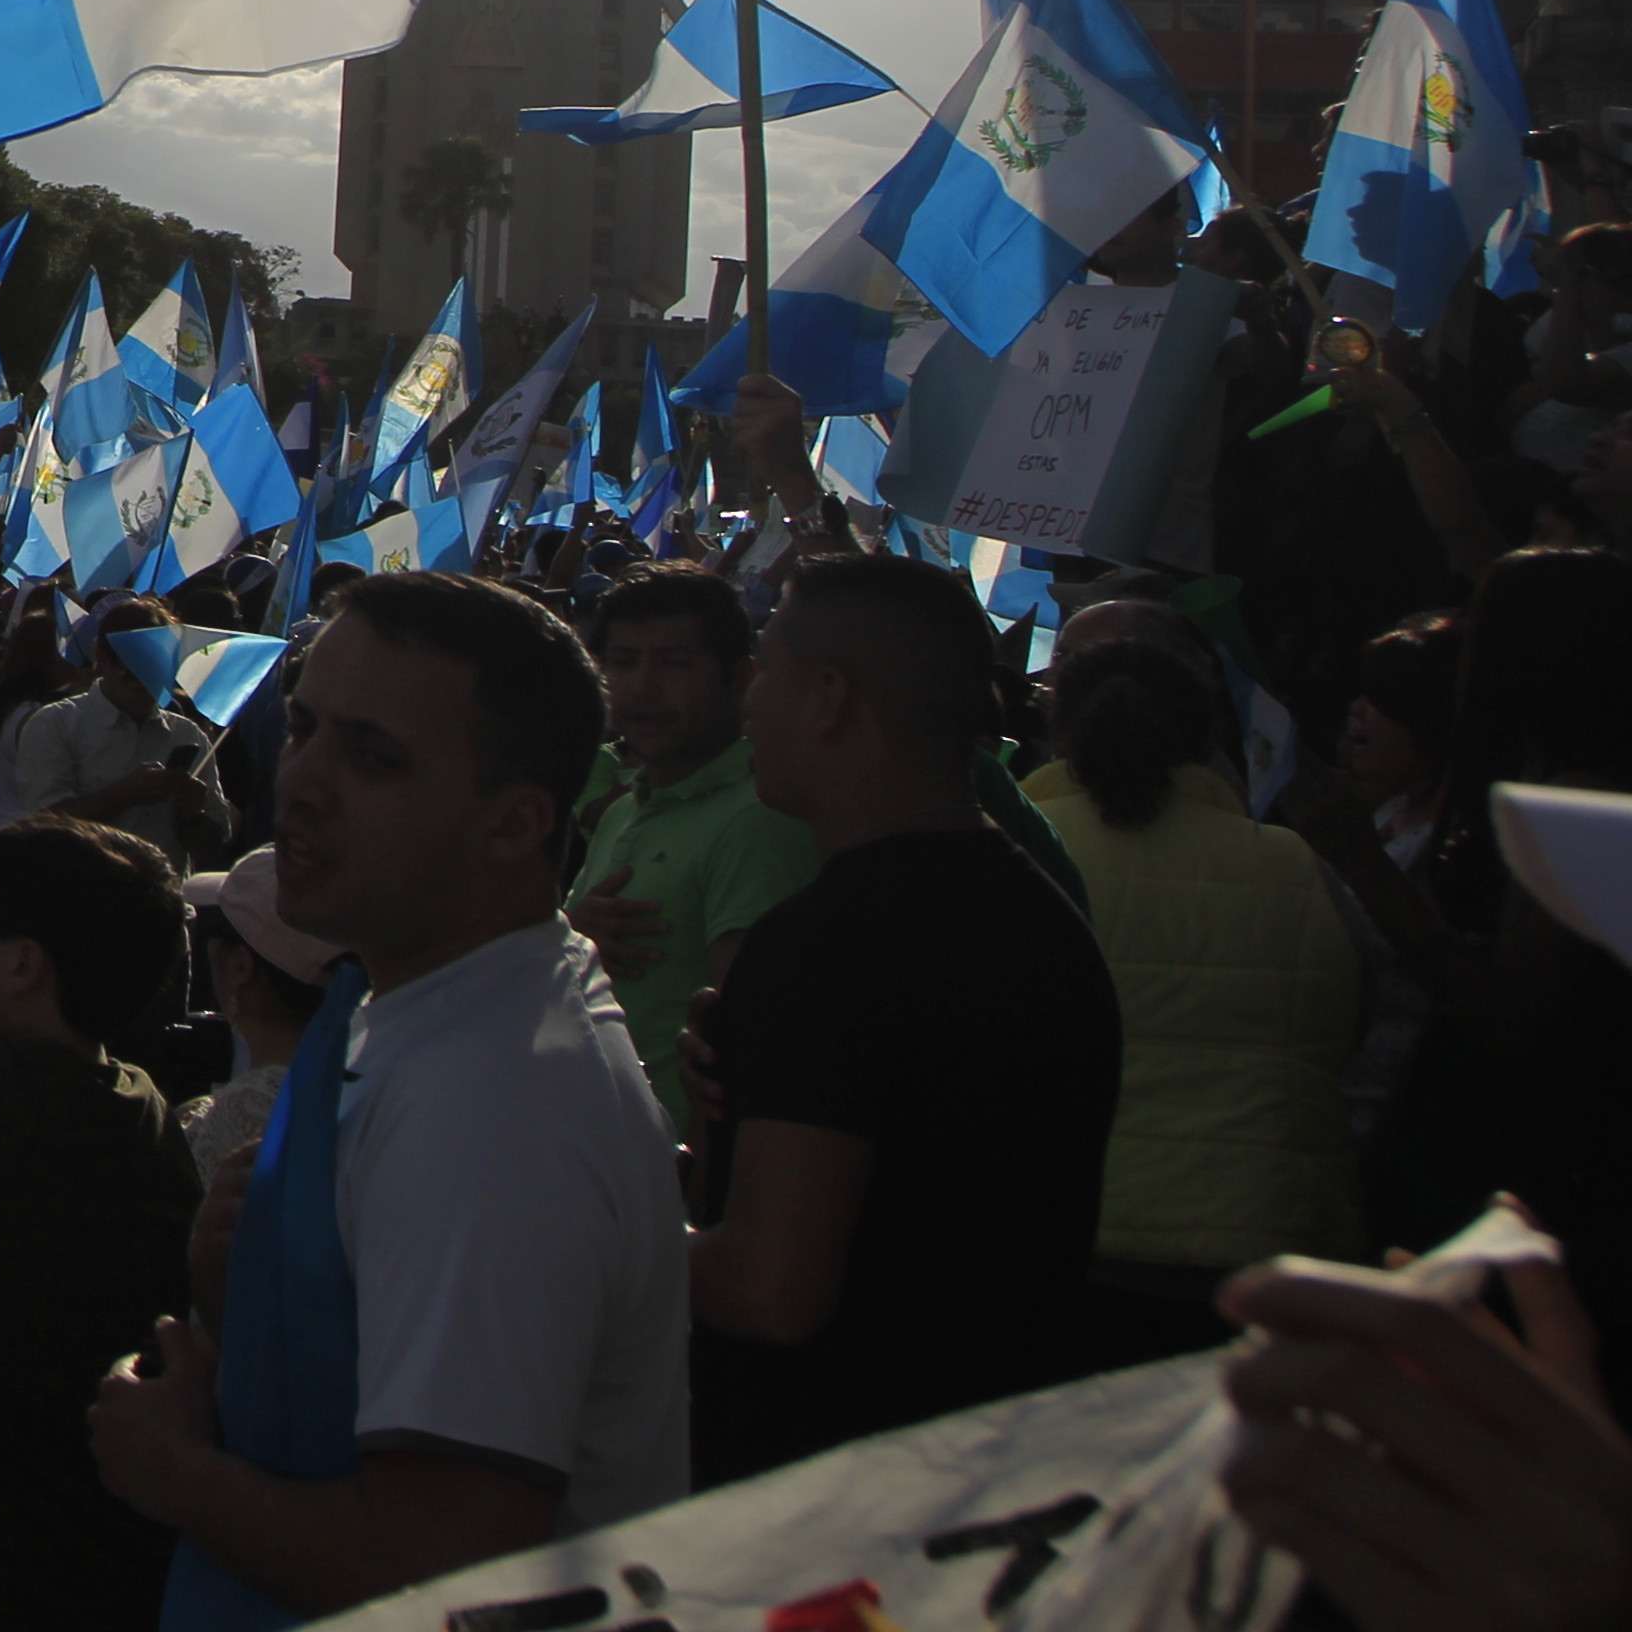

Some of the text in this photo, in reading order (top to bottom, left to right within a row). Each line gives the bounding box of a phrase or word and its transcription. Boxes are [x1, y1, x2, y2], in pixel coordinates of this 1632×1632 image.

[1064, 308, 1092, 330] DE
[1032, 350, 1050, 374] YA
[1030, 394, 1092, 440] OPM
[1017, 454, 1058, 472] ESTAS
